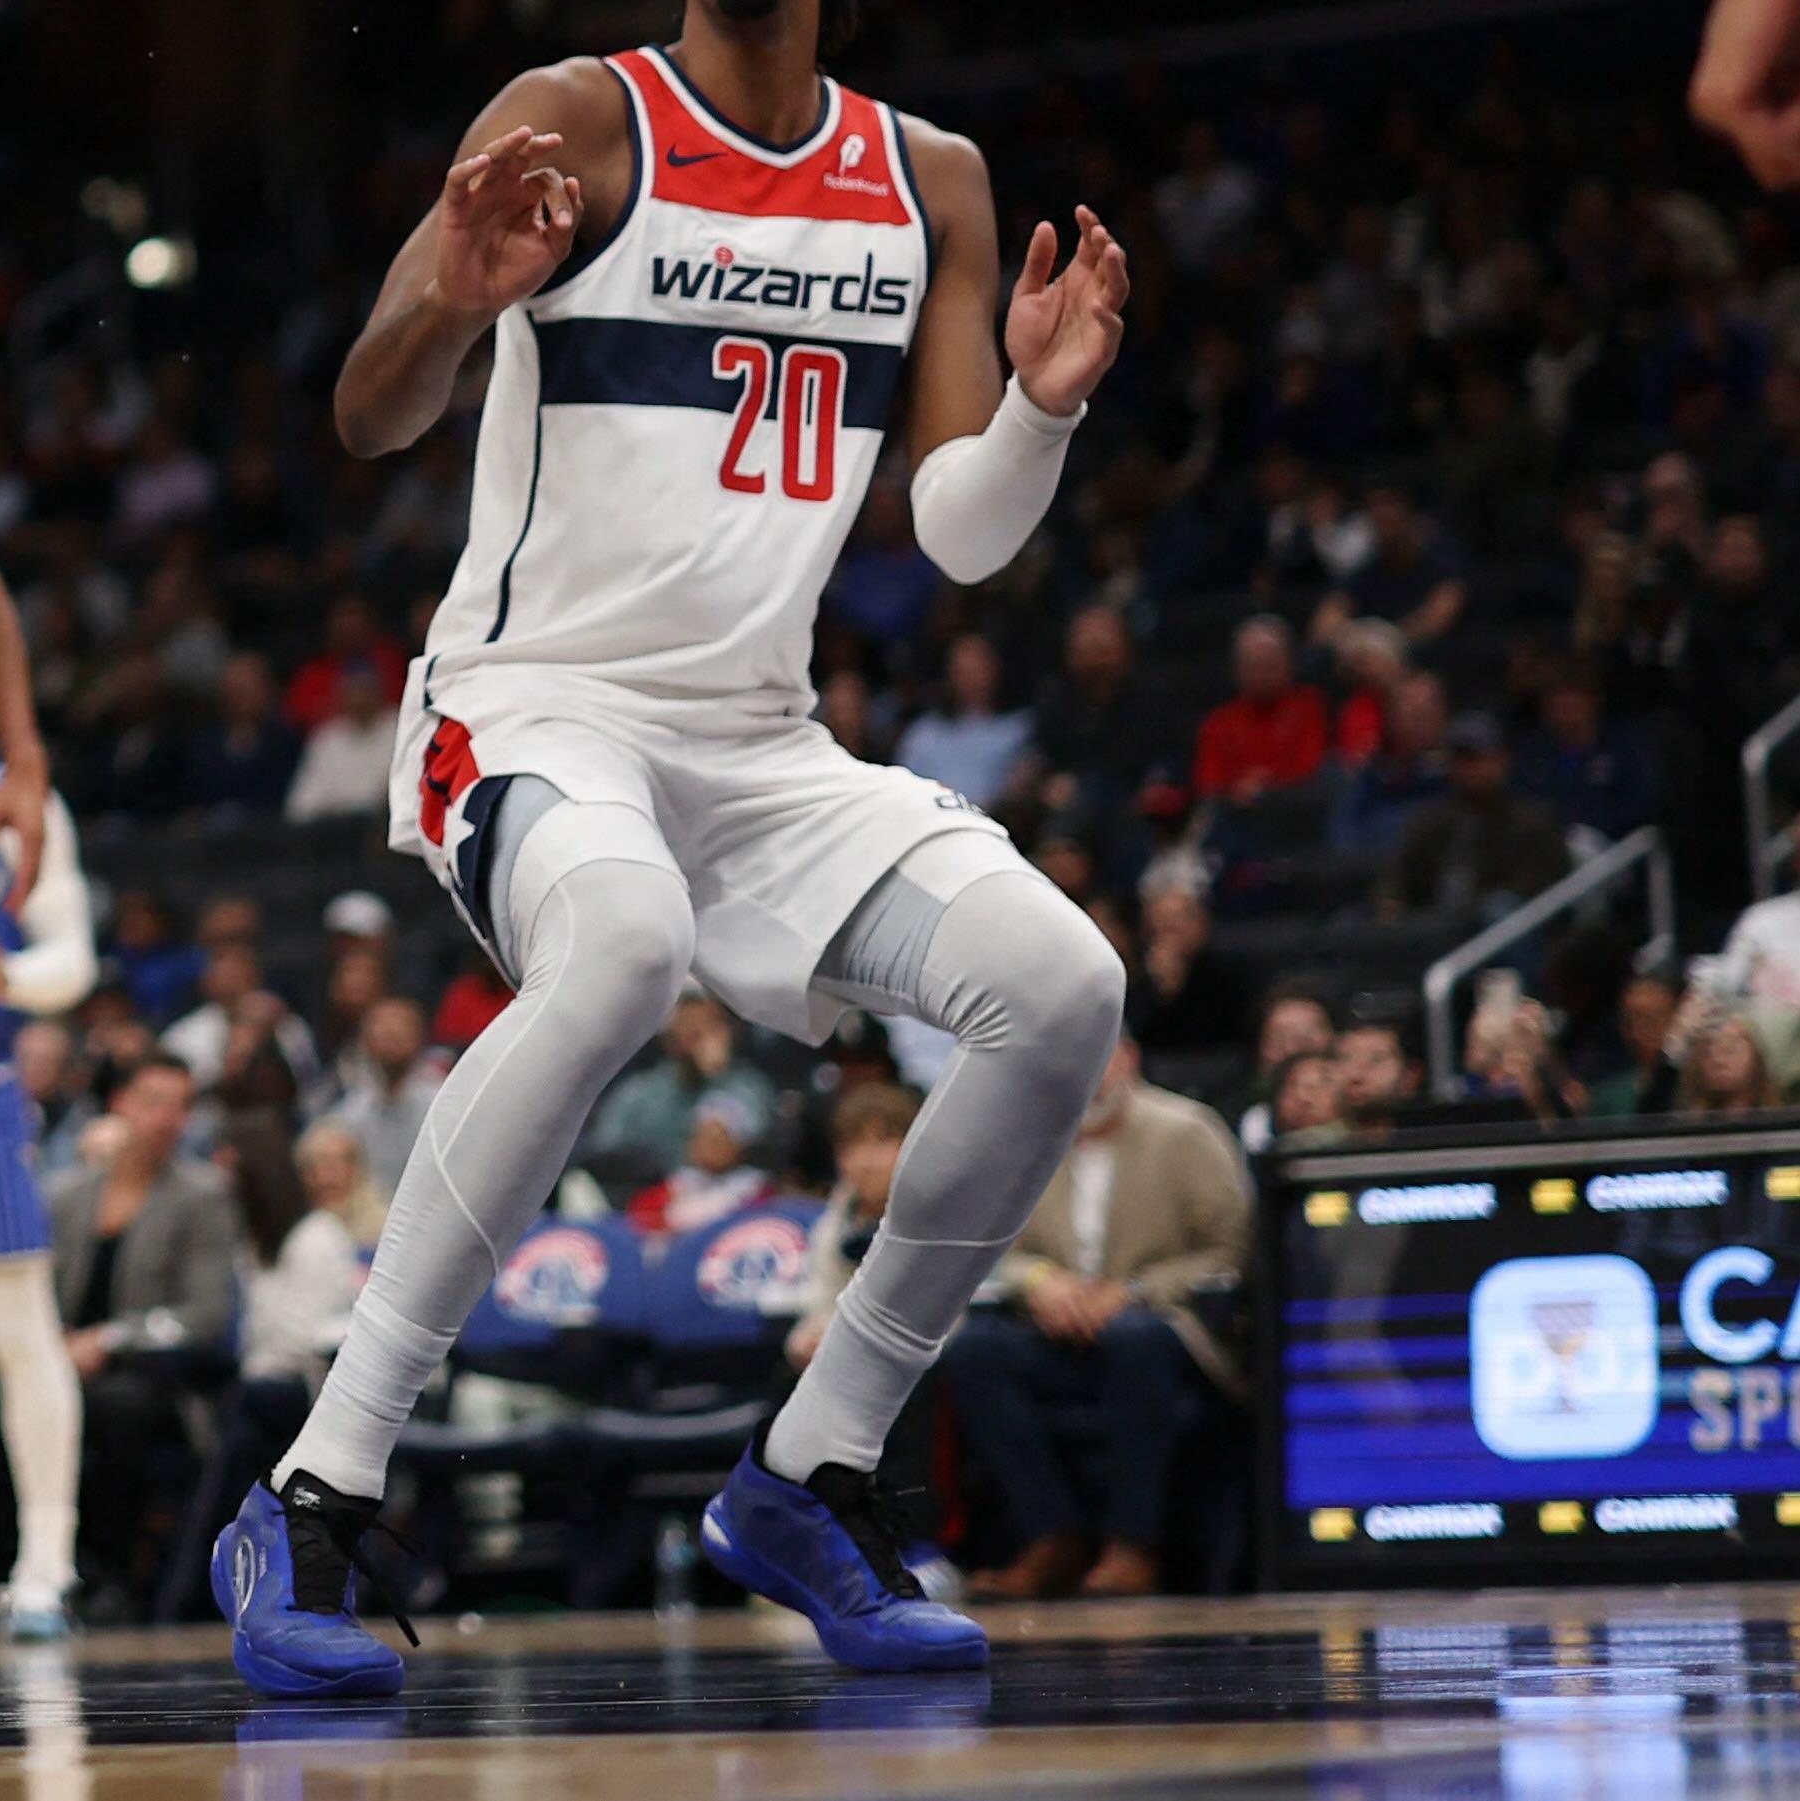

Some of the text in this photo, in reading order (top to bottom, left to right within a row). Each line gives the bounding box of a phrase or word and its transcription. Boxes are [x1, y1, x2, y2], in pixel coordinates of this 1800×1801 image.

[651, 246, 911, 316] wizards
[712, 335, 848, 502] 20
[1680, 1246, 1800, 1363] C
